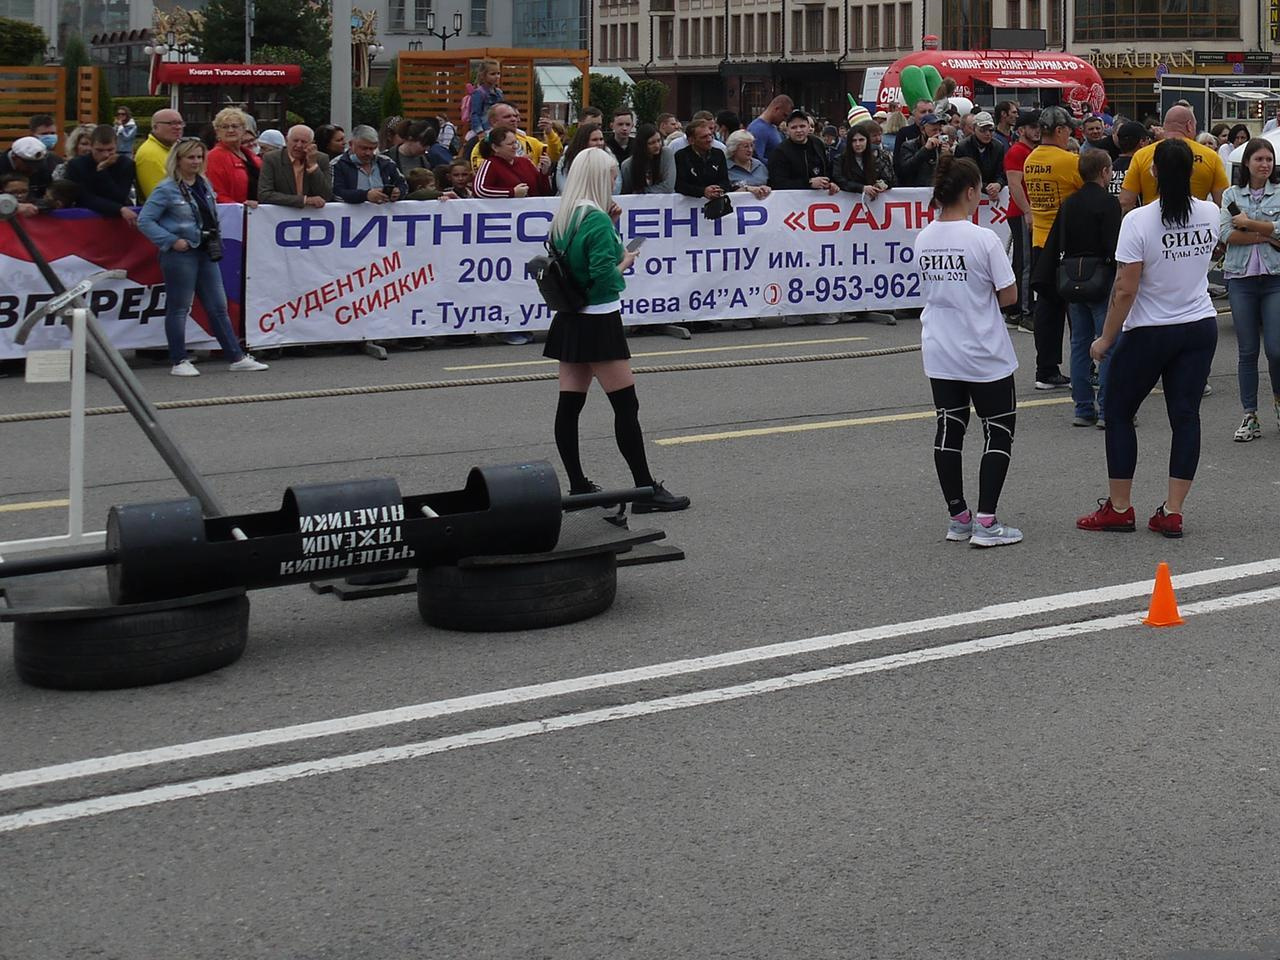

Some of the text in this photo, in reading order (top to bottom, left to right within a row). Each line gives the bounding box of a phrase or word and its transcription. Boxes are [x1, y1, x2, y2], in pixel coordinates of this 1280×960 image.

[948, 58, 1079, 71] САМАЯ-ВКУСНАЯ-ШАУРМА.РФ
[1088, 51, 1196, 68] RESTAURAN
[188, 68, 286, 77] Книги Тульской области
[1025, 165, 1052, 174] СУДЬЯ
[275, 205, 768, 249] ФИТНЕСЕНТР
[1162, 228, 1213, 248] СИЛА
[457, 256, 512, 283] 200
[645, 256, 677, 276] от
[685, 246, 760, 273] ТГПУ
[768, 251, 810, 269] им.
[818, 243, 844, 267] Л.
[852, 242, 876, 266] Н.
[1162, 244, 1212, 261] Тулы 2021
[919, 255, 968, 271] СИЛА
[946, 271, 967, 281] 2021
[258, 251, 403, 334] СТУДЕНТАМ
[334, 263, 435, 326] СКИДКИ!
[411, 308, 426, 325] г.
[436, 301, 510, 329] Тула,
[519, 303, 551, 326] ул
[787, 271, 921, 304] 8-953-962
[299, 504, 405, 533] АТЛЕТИКИ
[280, 545, 416, 575] ФЕДЕРАЦИЯ
